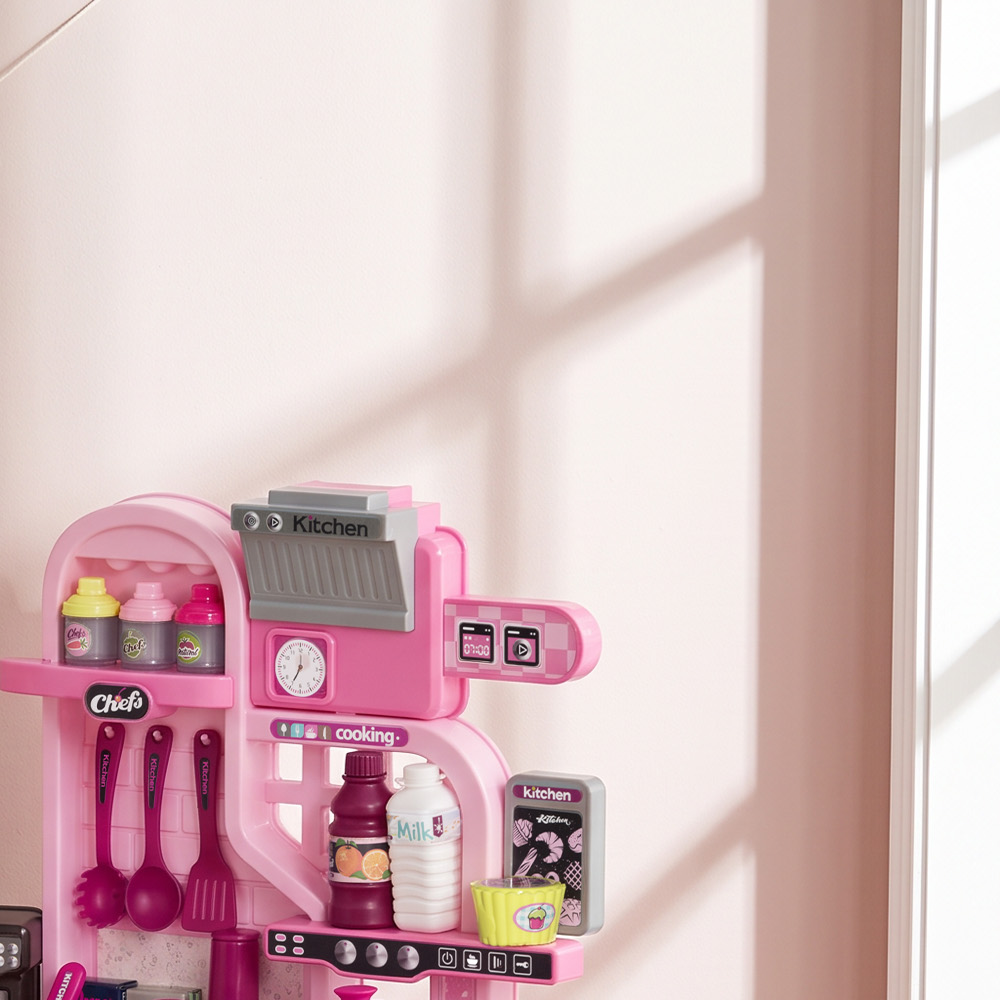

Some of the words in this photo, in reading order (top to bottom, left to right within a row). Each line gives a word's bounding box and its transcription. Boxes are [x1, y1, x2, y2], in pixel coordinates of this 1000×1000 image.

[293, 515, 368, 537] Kitchen
[464, 643, 489, 656] 07:00
[90, 690, 143, 713] Chefs
[335, 726, 395, 747] cooking
[101, 754, 110, 787] Kitchen
[149, 758, 157, 791] Kitchen
[523, 786, 571, 801] kitchen
[536, 814, 571, 825] Kitchen
[397, 820, 434, 841] Milk
